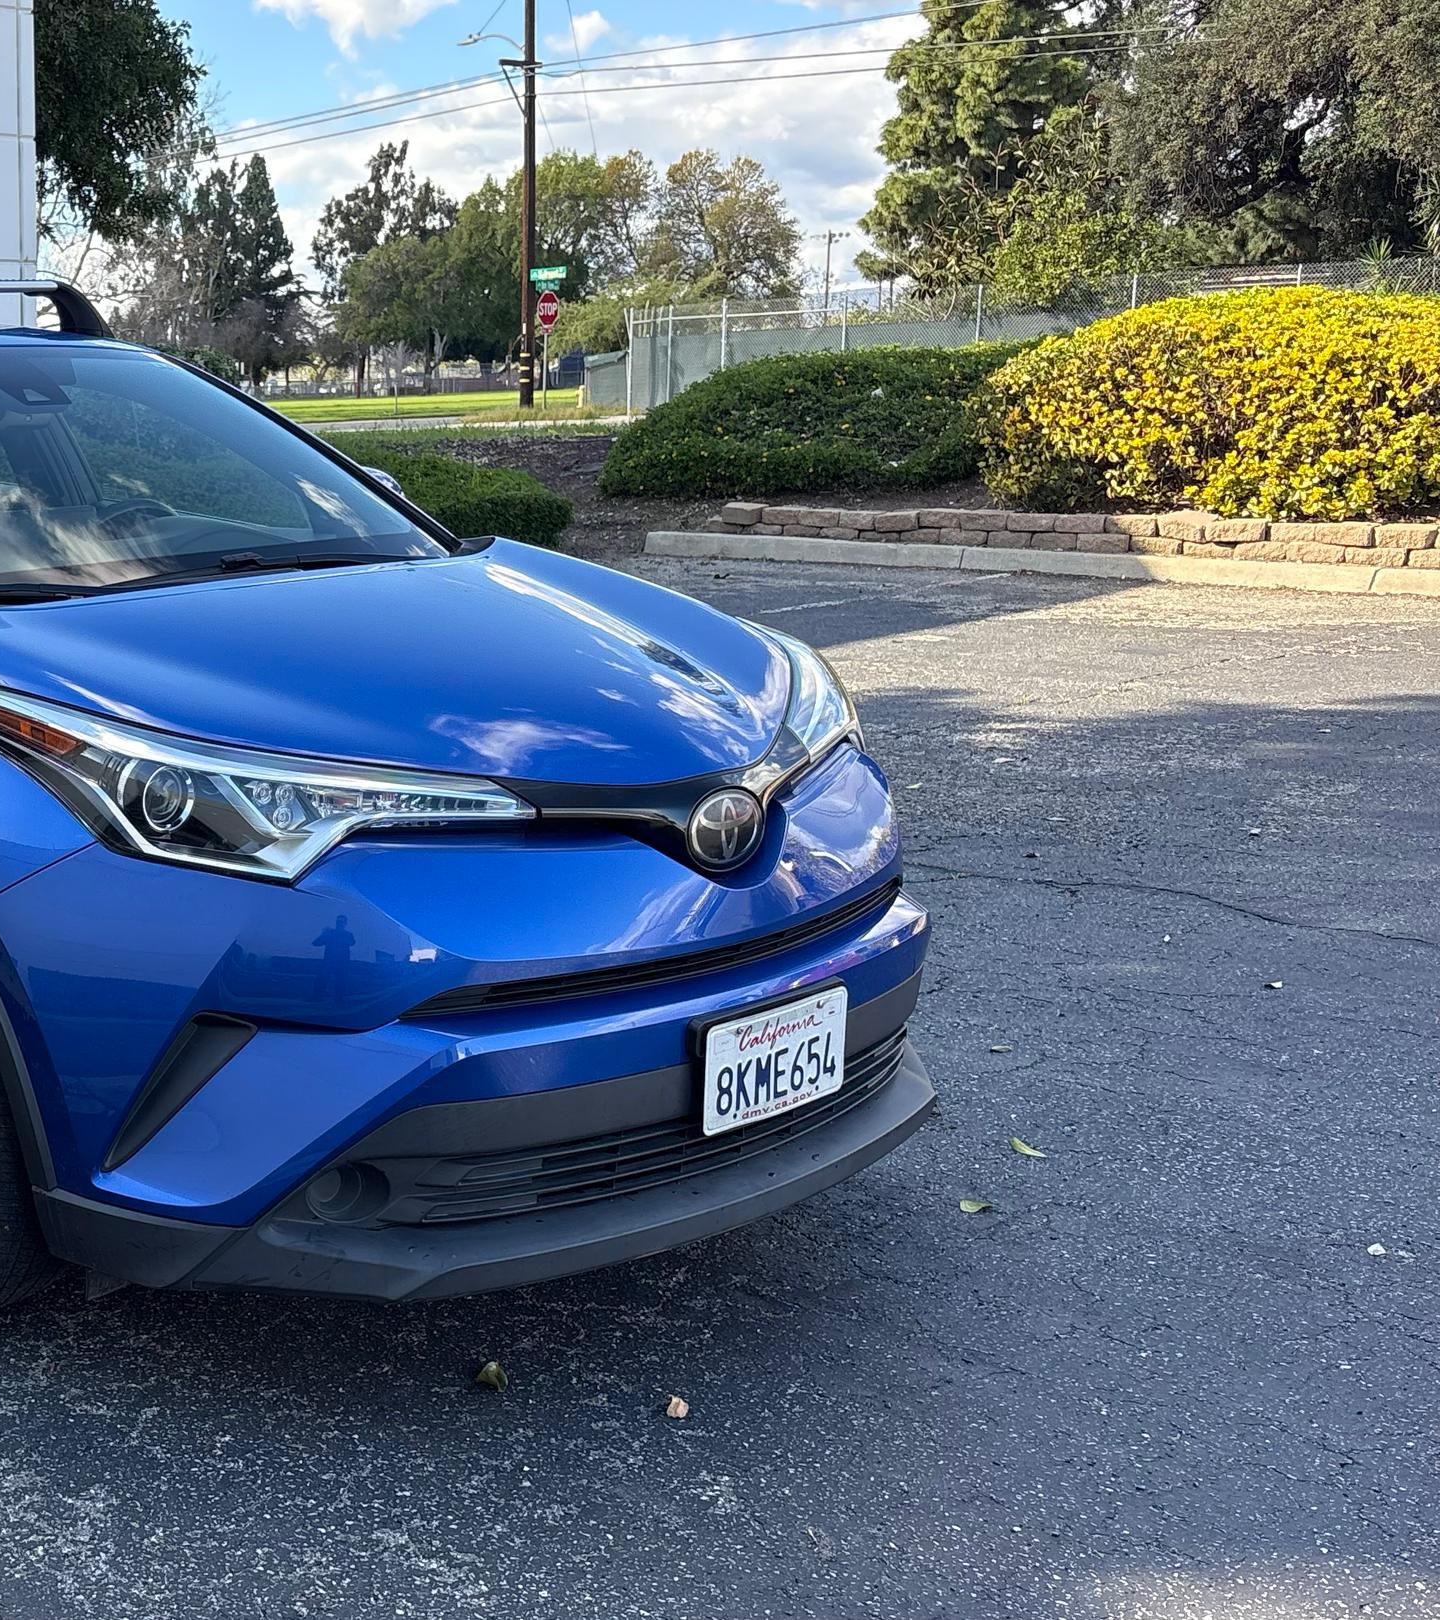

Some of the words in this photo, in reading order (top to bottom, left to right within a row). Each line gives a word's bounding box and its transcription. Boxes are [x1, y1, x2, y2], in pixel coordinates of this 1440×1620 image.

[540, 302, 557, 316] STOP
[740, 1014, 822, 1051] California
[716, 1031, 836, 1116] 8KME654
[742, 1090, 813, 1119] dmv.ca.gov
